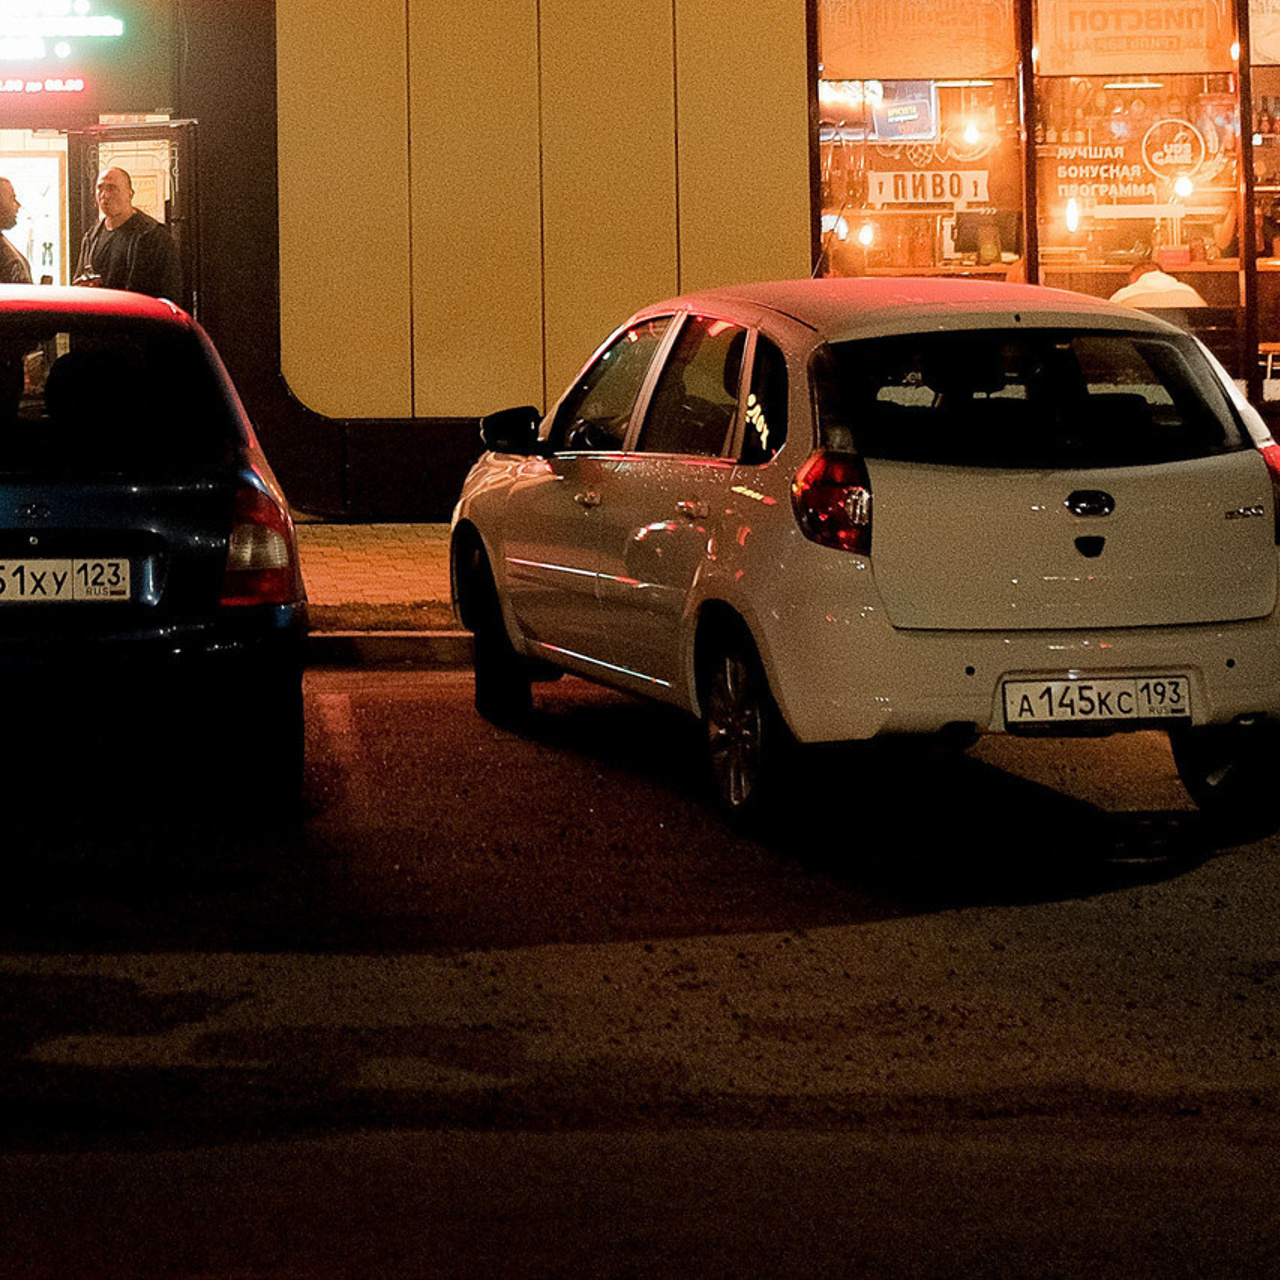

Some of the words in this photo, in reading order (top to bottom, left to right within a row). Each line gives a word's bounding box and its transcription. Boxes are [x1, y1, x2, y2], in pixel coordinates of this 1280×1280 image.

[1056, 145, 1125, 160] ЛУЧШАЯ
[1056, 164, 1141, 179] БОНУСНАЯ
[892, 173, 964, 201] ПИВО
[1057, 183, 1157, 197] ПРОГРАММА
[76, 562, 121, 587] 123
[1139, 681, 1182, 705] 193
